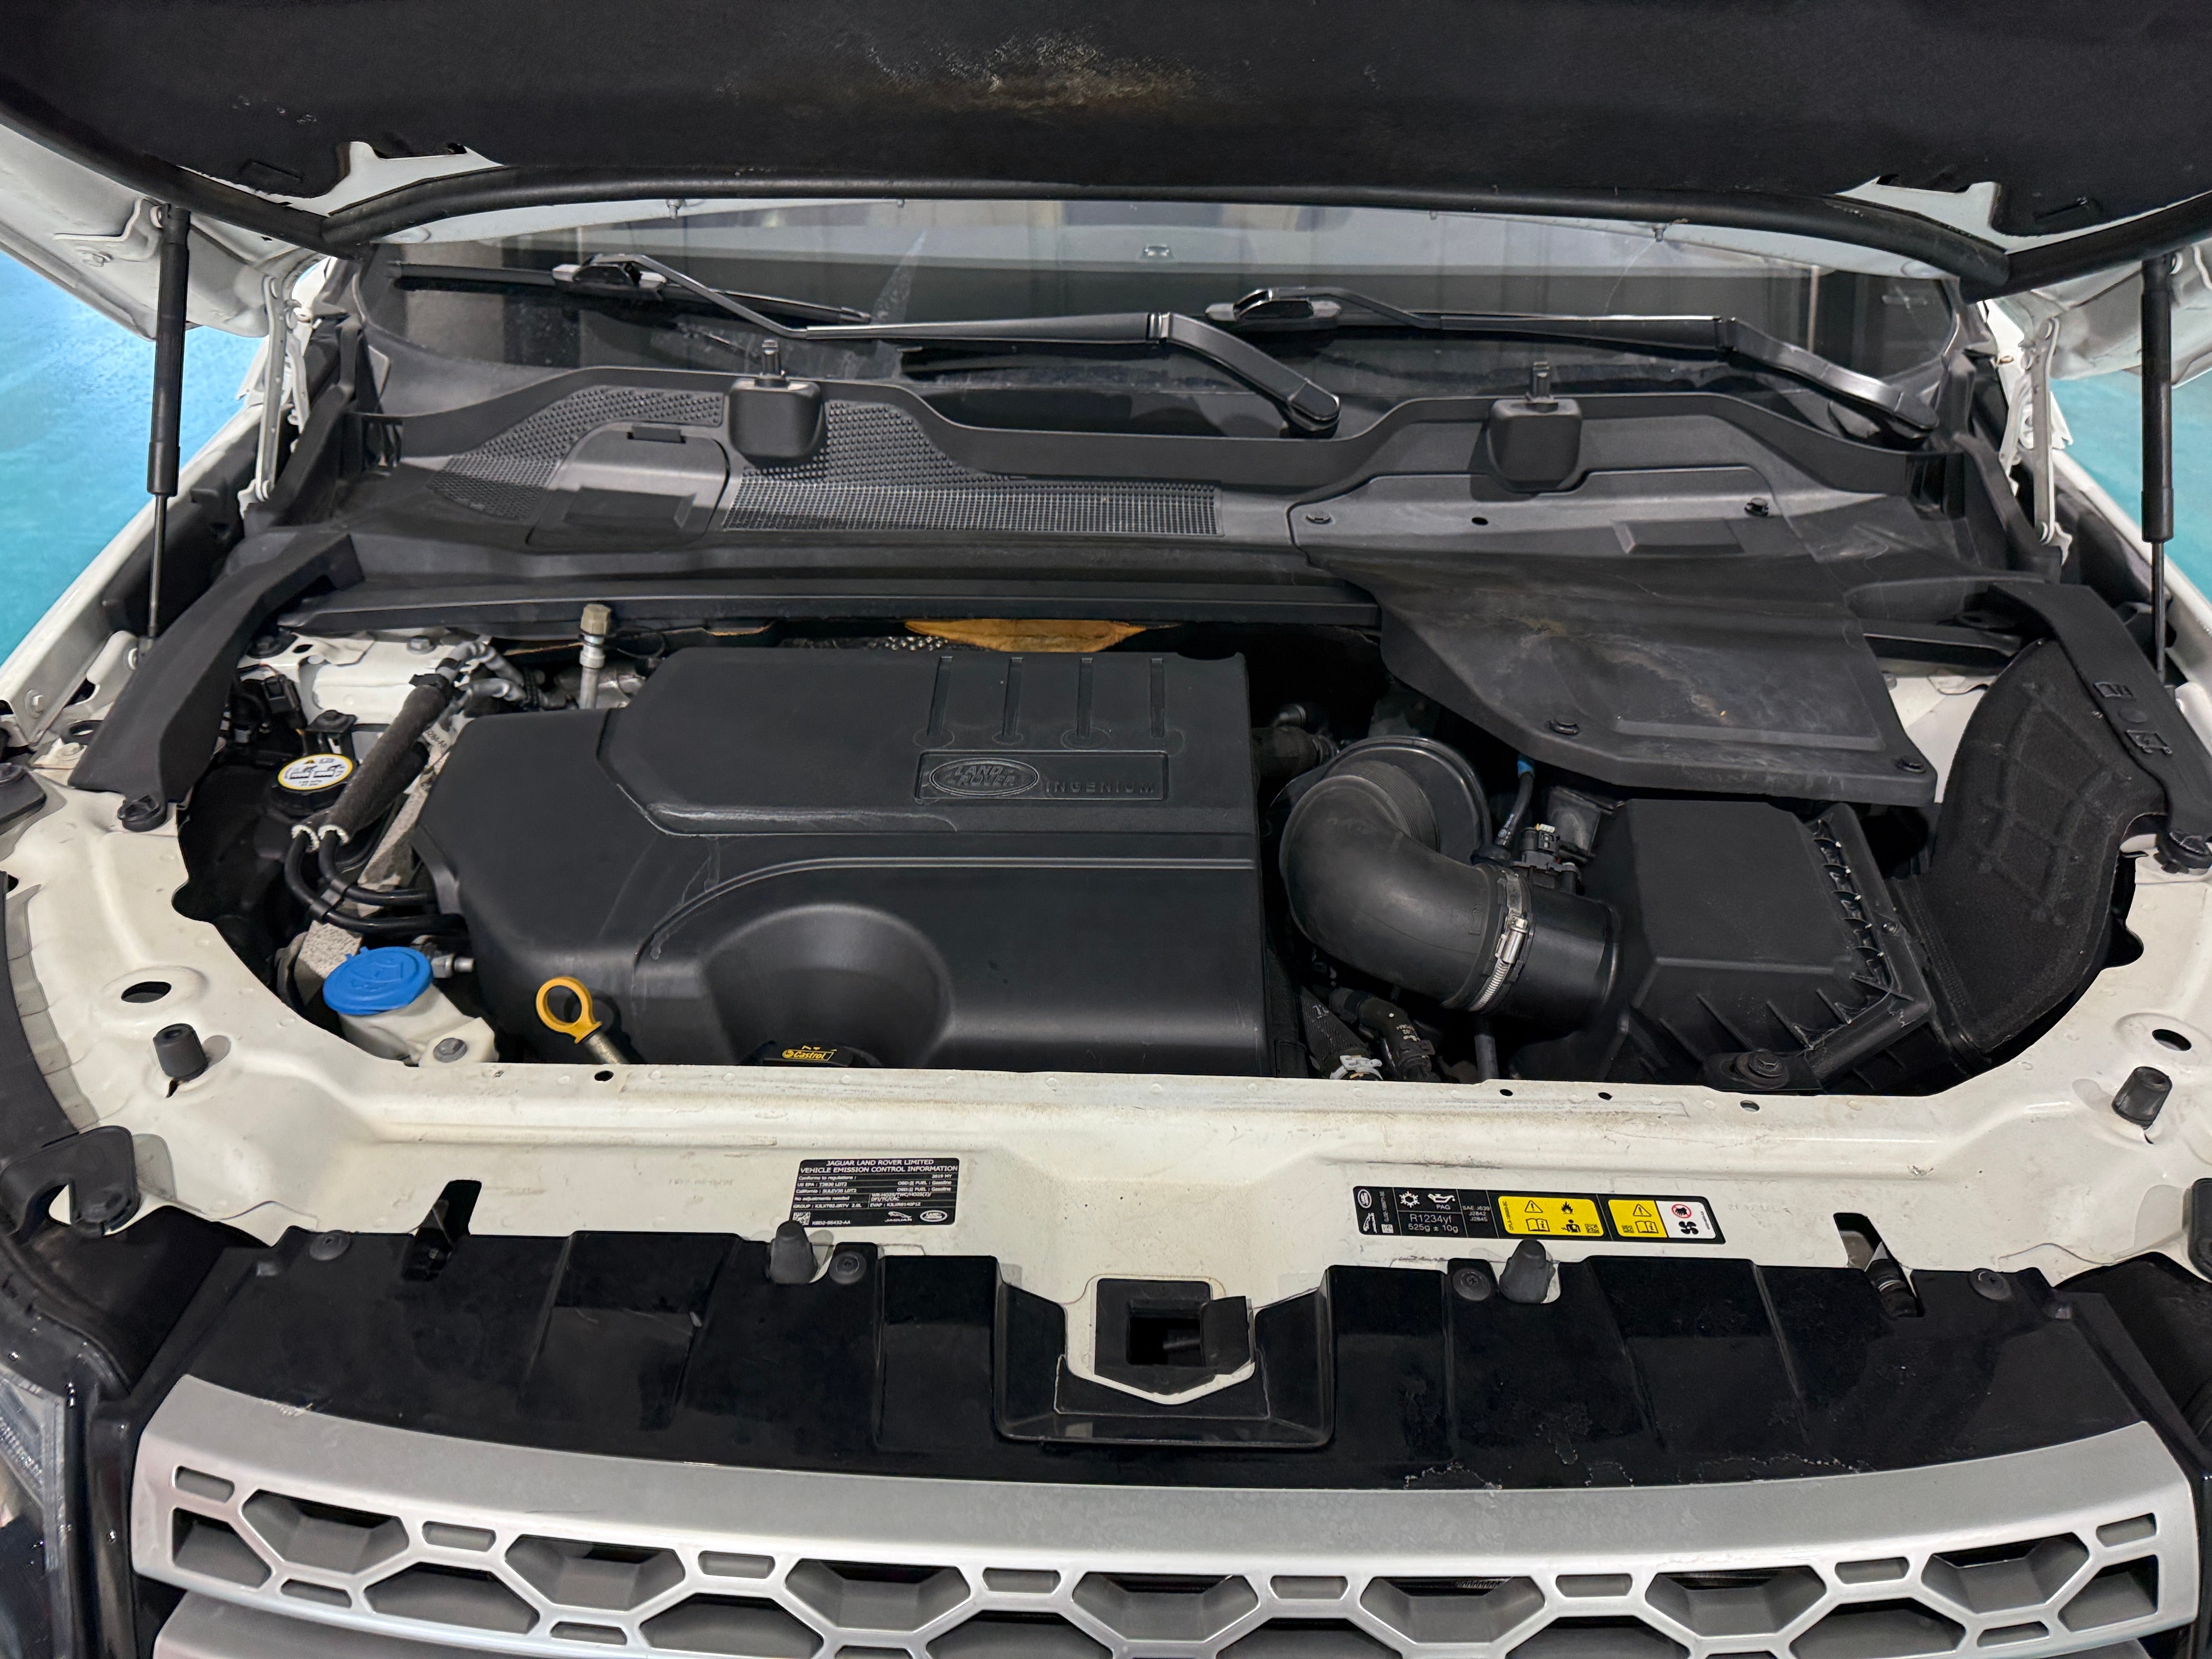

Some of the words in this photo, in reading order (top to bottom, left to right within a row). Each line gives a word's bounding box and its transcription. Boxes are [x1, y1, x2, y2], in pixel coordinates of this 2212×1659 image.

[955, 766, 1002, 776] LAND
[958, 775, 1016, 787] ROVER
[1045, 781, 1154, 794] INGENIUM
[1410, 1214, 1452, 1224] R1234yf
[1408, 1223, 1430, 1232] 525g
[1442, 1225, 1458, 1234] 10g
